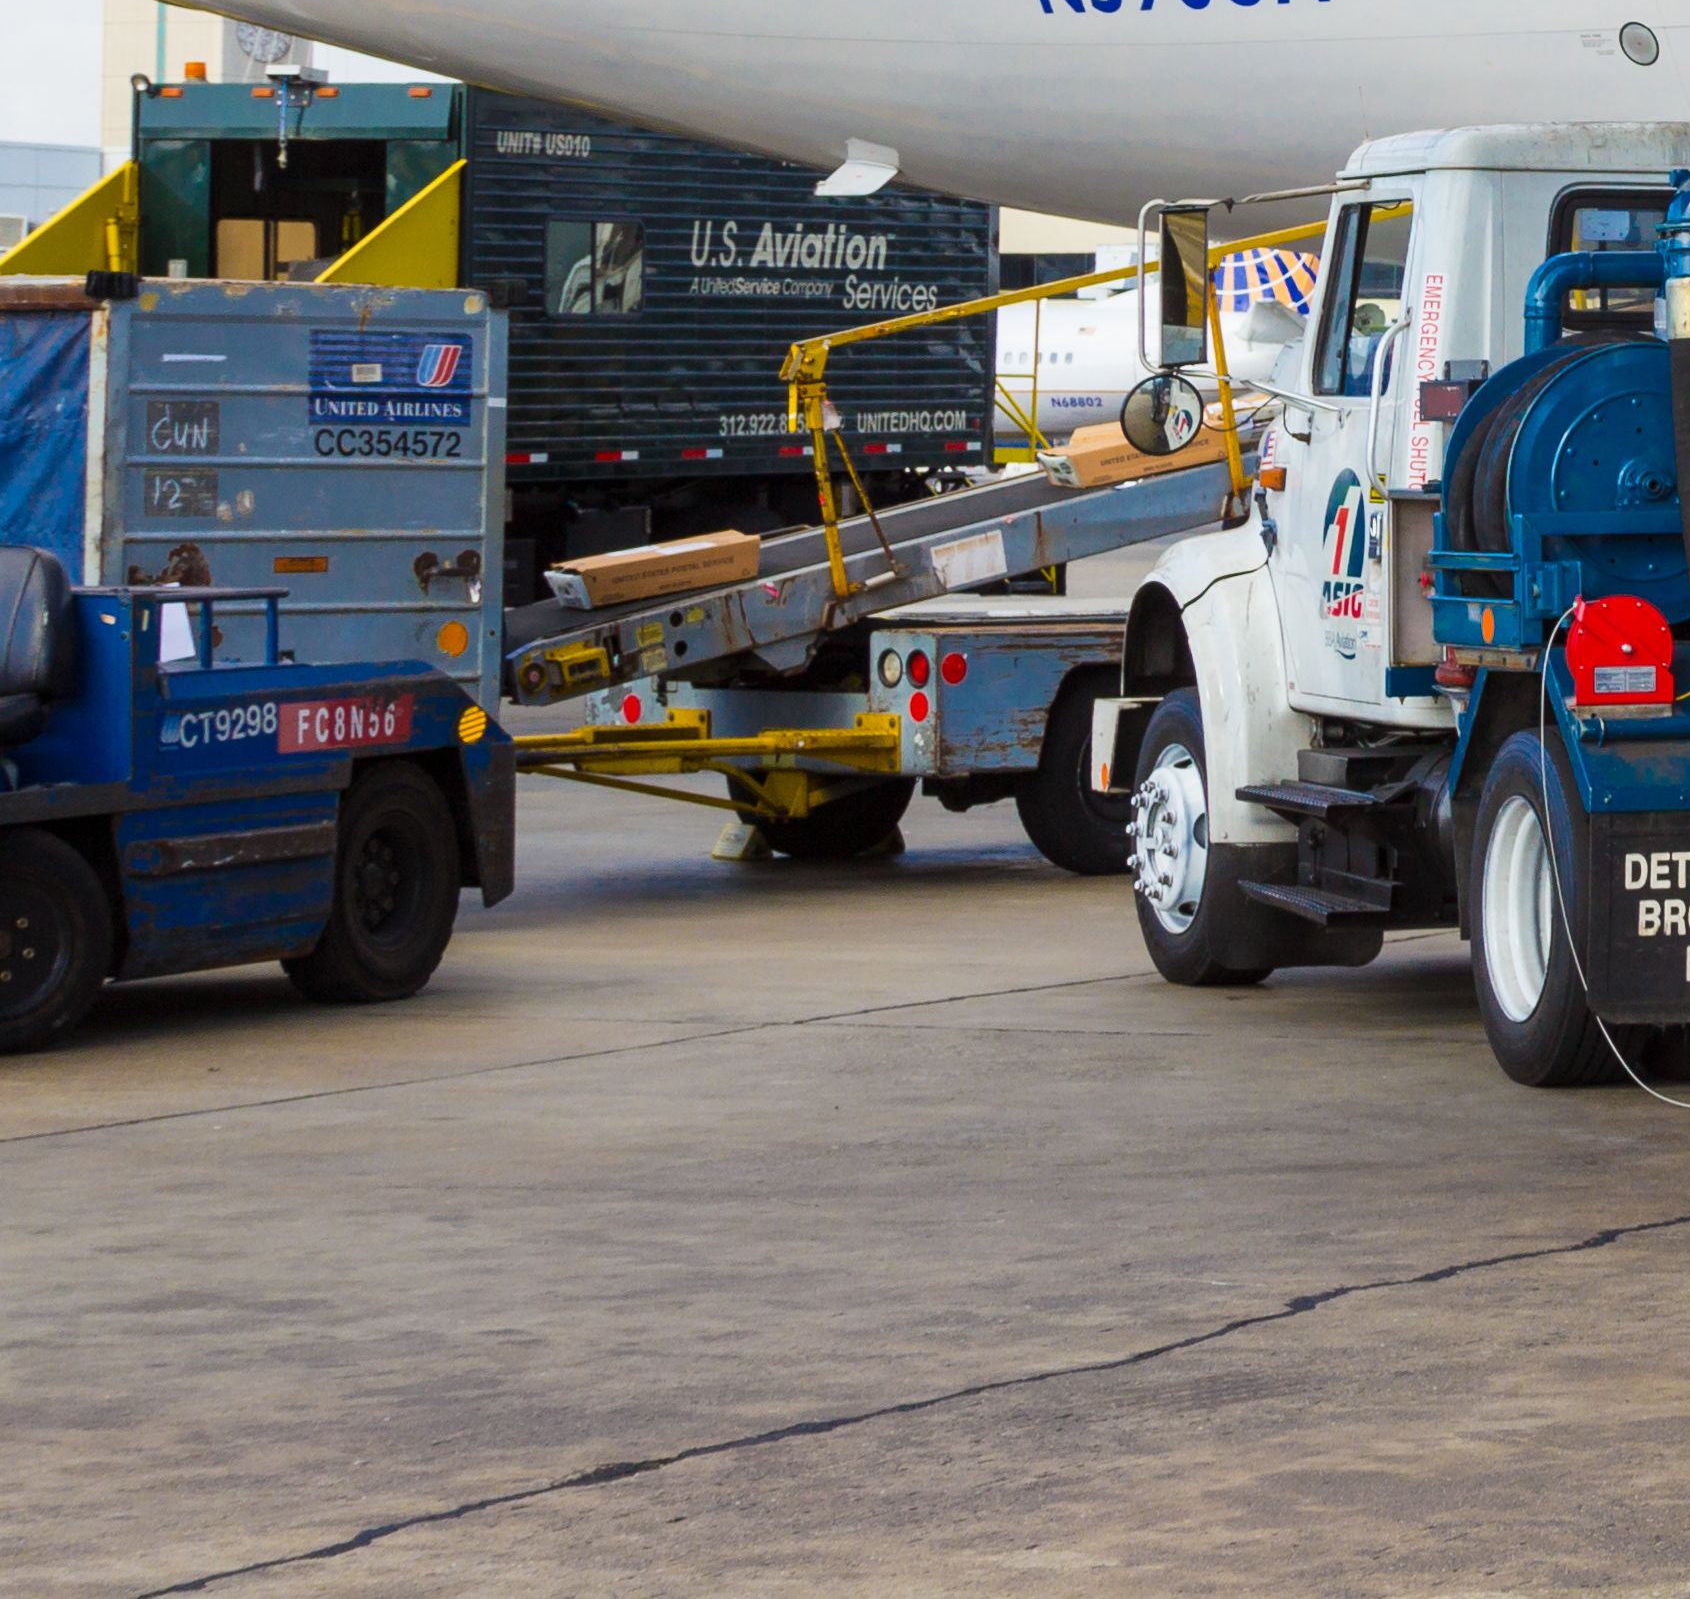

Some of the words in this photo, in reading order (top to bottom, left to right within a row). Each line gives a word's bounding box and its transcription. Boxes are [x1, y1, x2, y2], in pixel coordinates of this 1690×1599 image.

[497, 130, 542, 154] UNIT#
[690, 220, 742, 267] U.S.
[750, 222, 888, 270] Aviation
[782, 278, 834, 299] Company
[843, 274, 938, 311] Services
[1417, 274, 1444, 383] EMERGENCY
[315, 398, 379, 417] UNITED
[384, 399, 462, 418] AIRLINES
[1051, 396, 1103, 409] N68802
[857, 410, 966, 434] UNITEDHQ.COM
[314, 428, 461, 457] CC354572
[179, 702, 277, 748] CT9298
